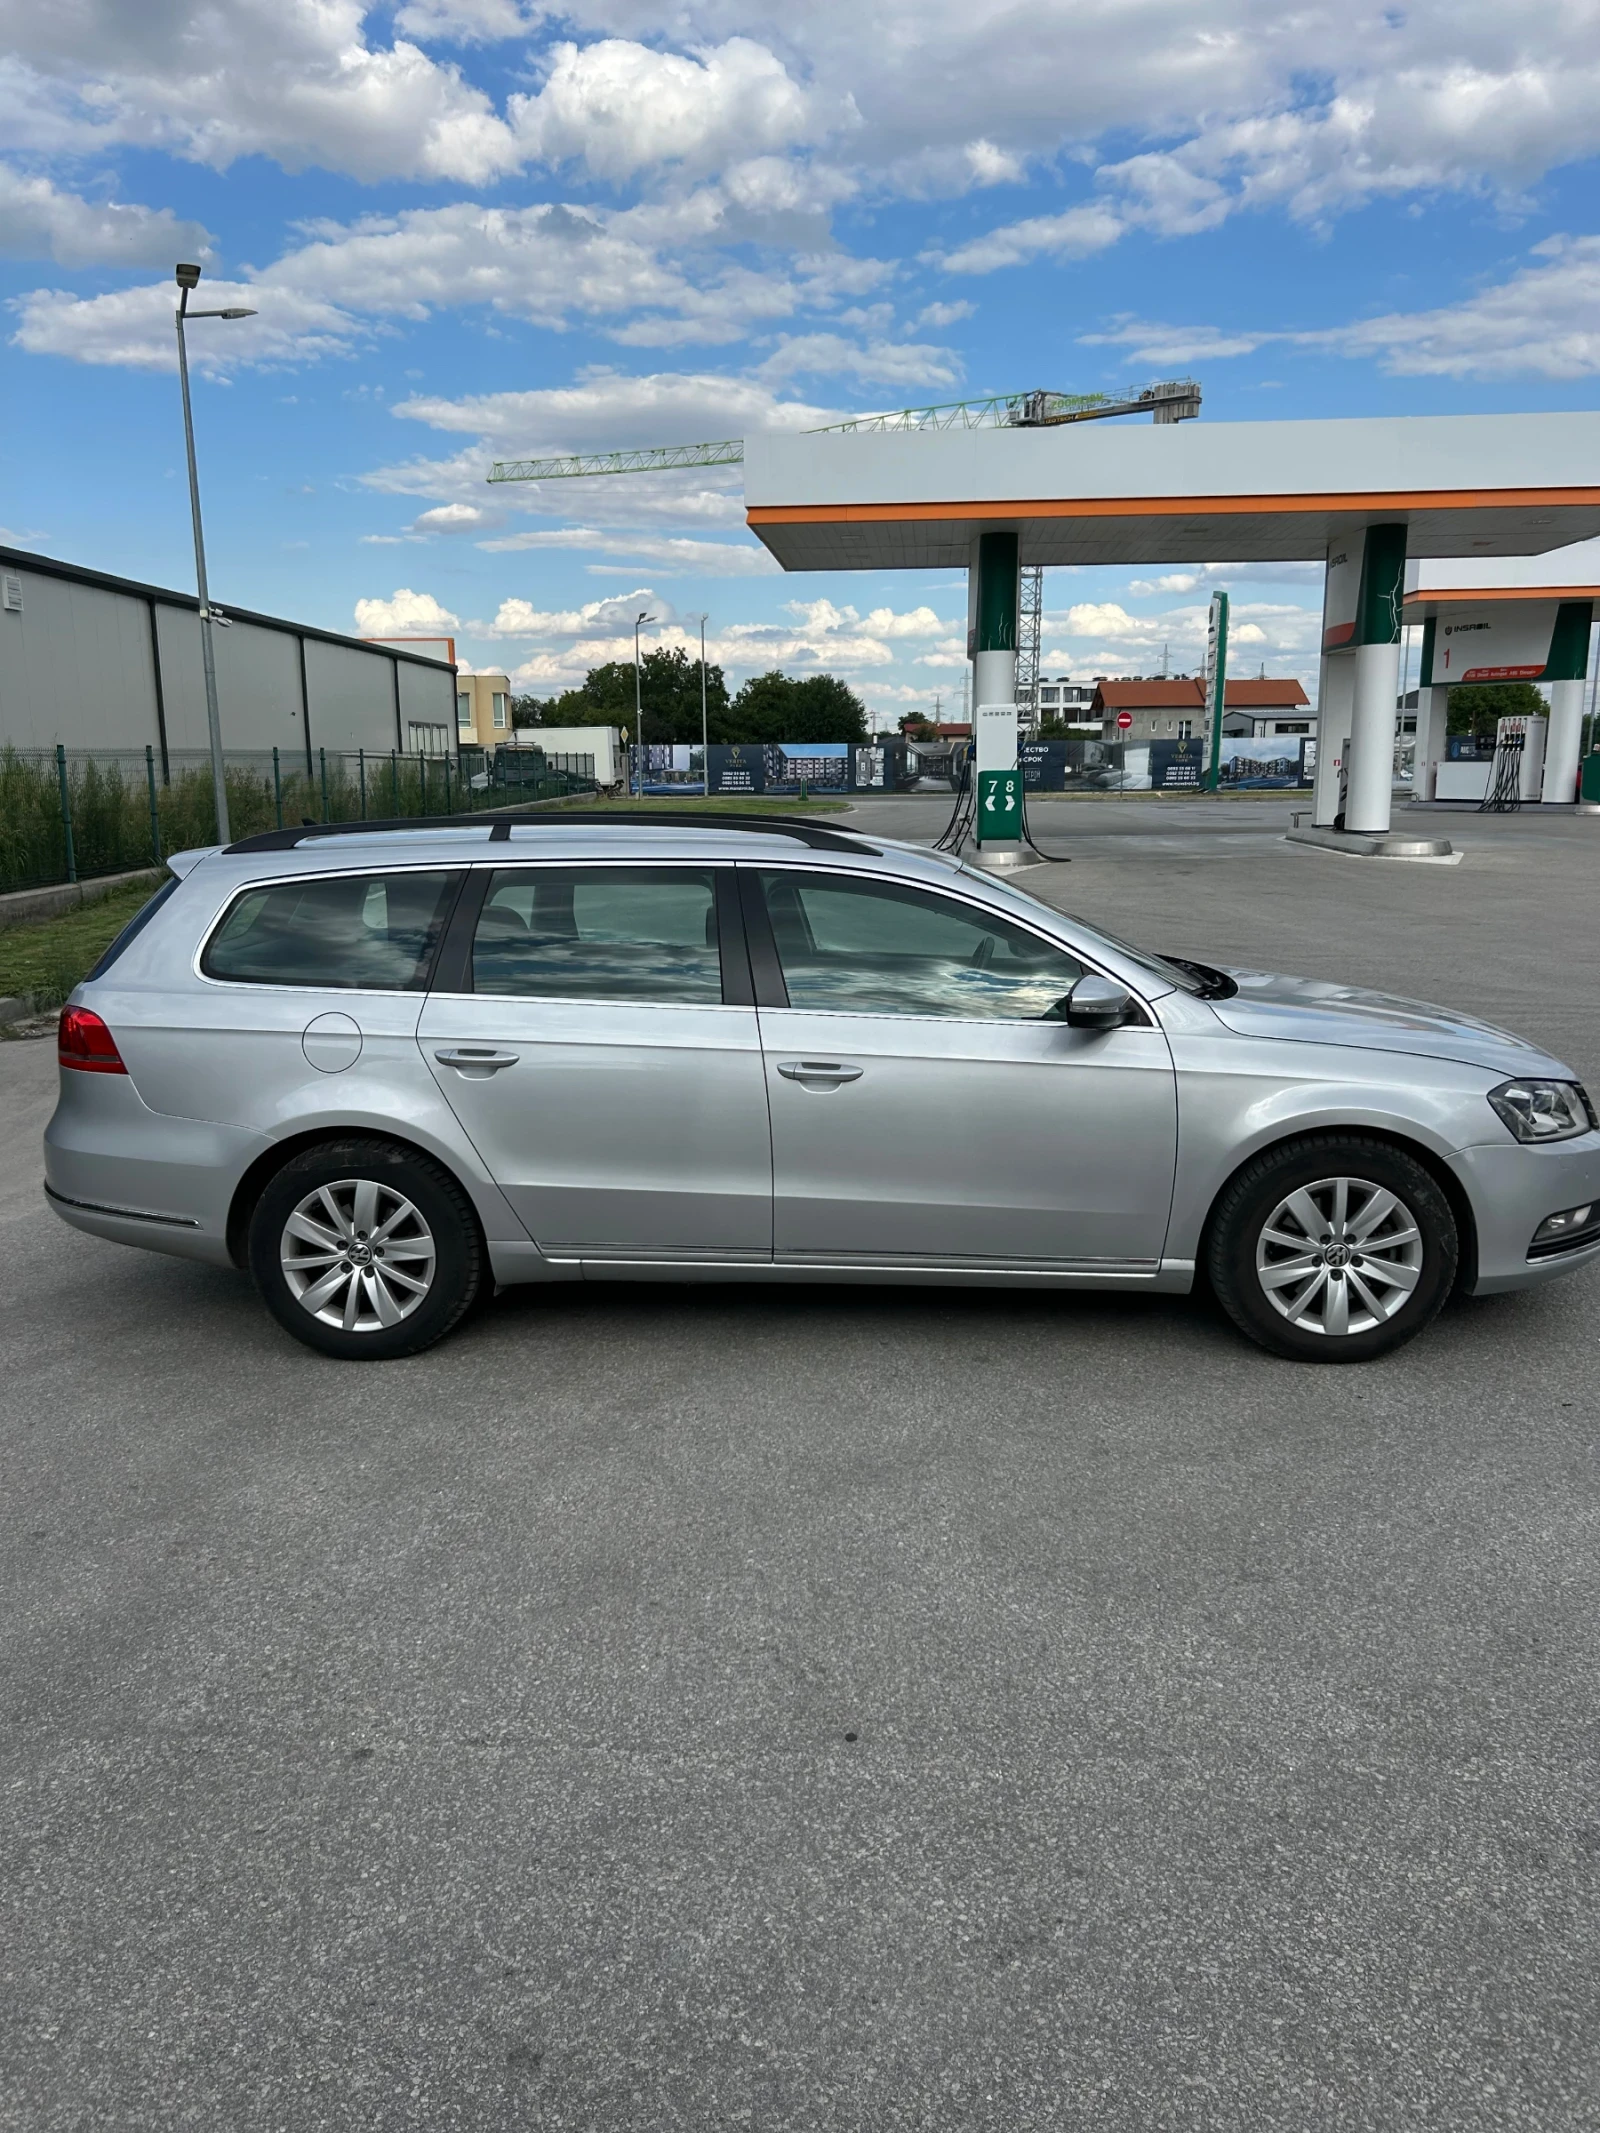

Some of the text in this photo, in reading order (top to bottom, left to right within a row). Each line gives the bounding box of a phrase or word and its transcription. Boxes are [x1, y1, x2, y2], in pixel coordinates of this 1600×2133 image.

[1454, 622, 1492, 632] INSAOIL
[1443, 648, 1450, 669] 1
[988, 780, 1014, 793] 7 8
